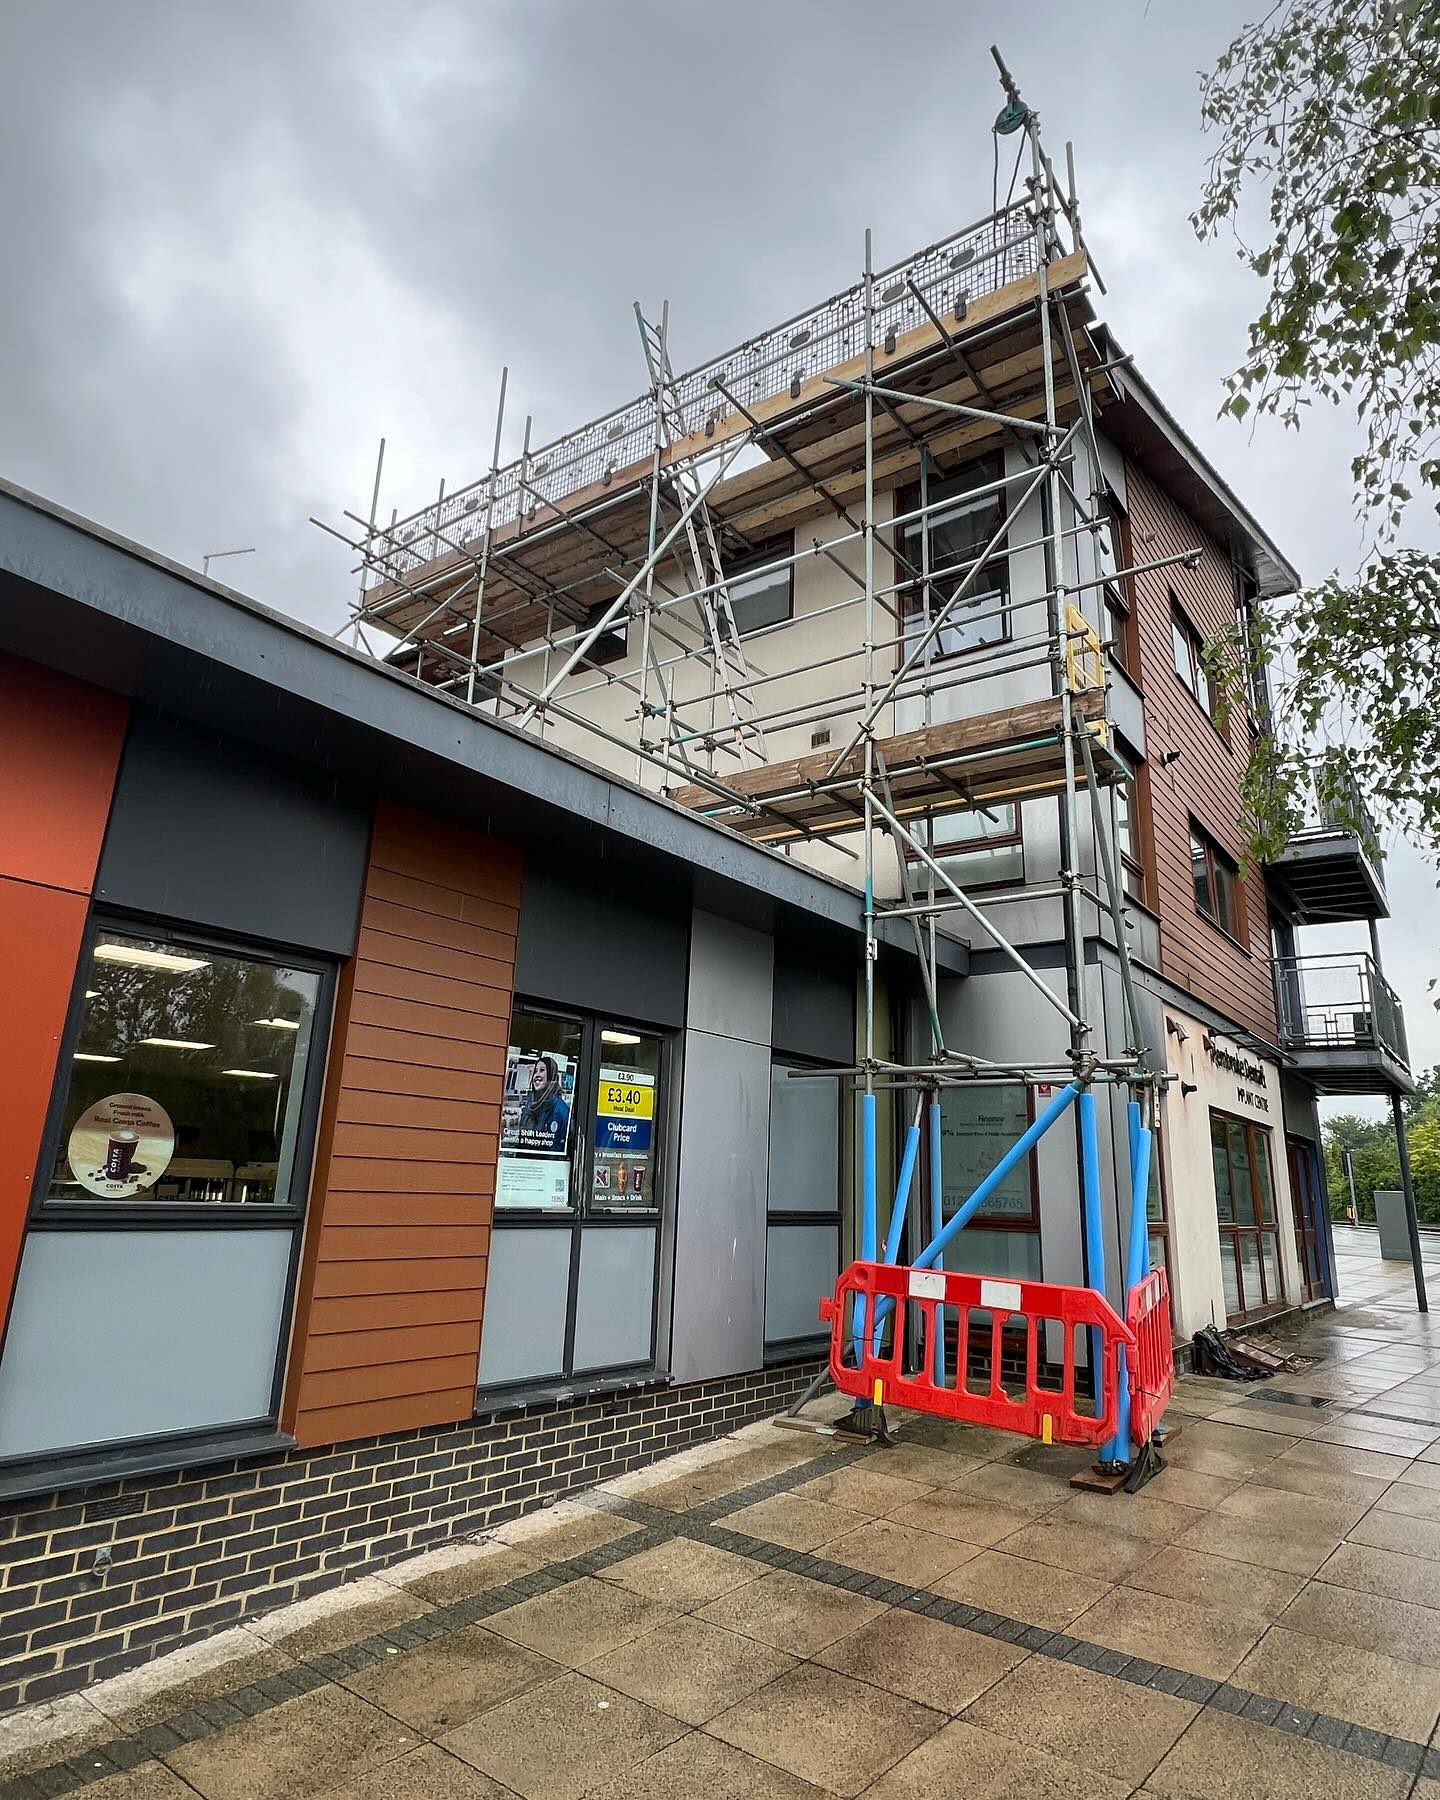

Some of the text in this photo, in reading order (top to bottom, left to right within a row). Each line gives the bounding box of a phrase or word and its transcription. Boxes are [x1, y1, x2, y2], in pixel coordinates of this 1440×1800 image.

[618, 1072, 635, 1082] £3.90
[607, 1087, 641, 1105] £3.40
[112, 1117, 135, 1126] Costa
[135, 1120, 161, 1128] Coffee
[607, 1122, 638, 1133] Clubcard
[503, 1127, 556, 1139] Great Shift Leaders
[613, 1132, 631, 1142] Price
[525, 1136, 541, 1147] happy
[541, 1138, 554, 1147] shop
[110, 1148, 120, 1173] COSTA
